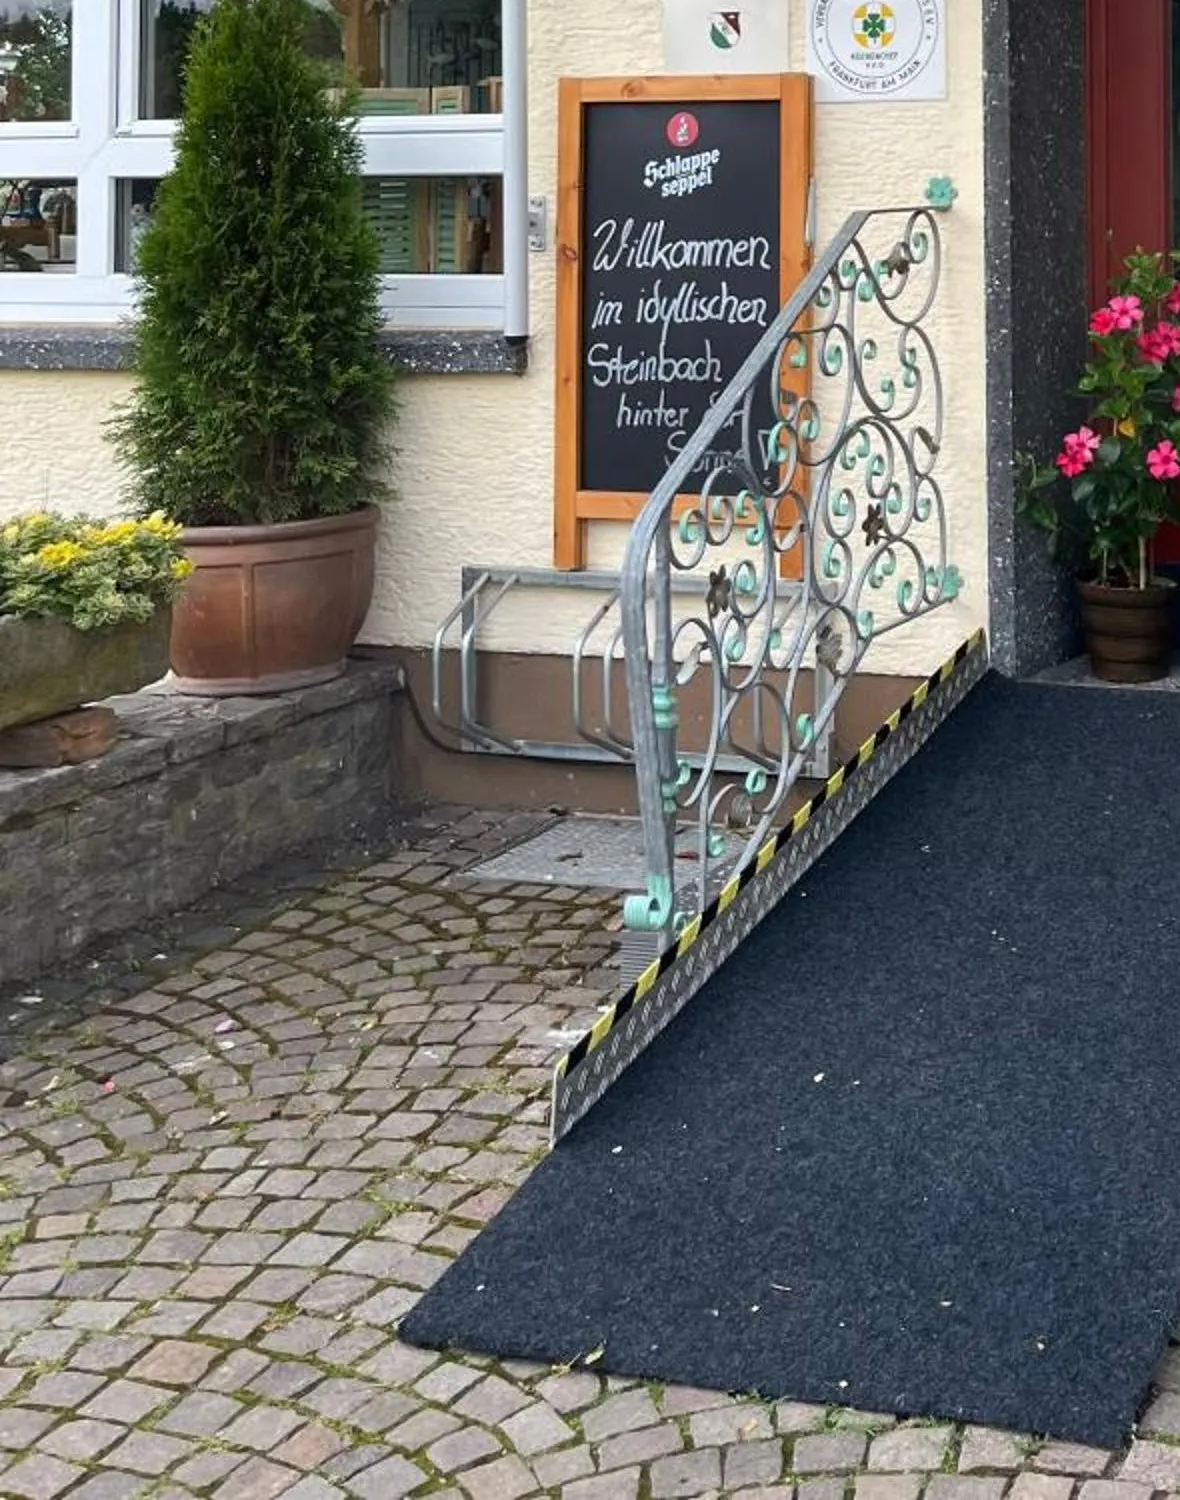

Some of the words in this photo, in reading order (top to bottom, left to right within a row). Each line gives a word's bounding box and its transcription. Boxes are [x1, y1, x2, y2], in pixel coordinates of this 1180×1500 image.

[881, 78, 897, 89] AM
[899, 60, 921, 79] MAIN
[643, 148, 720, 188] Schlappe
[661, 166, 712, 197] seppel
[592, 217, 772, 271] Willkommen
[591, 291, 623, 329] im
[635, 279, 767, 348] idyllischen
[587, 338, 722, 387] Steinbach
[616, 388, 690, 429] hinter
